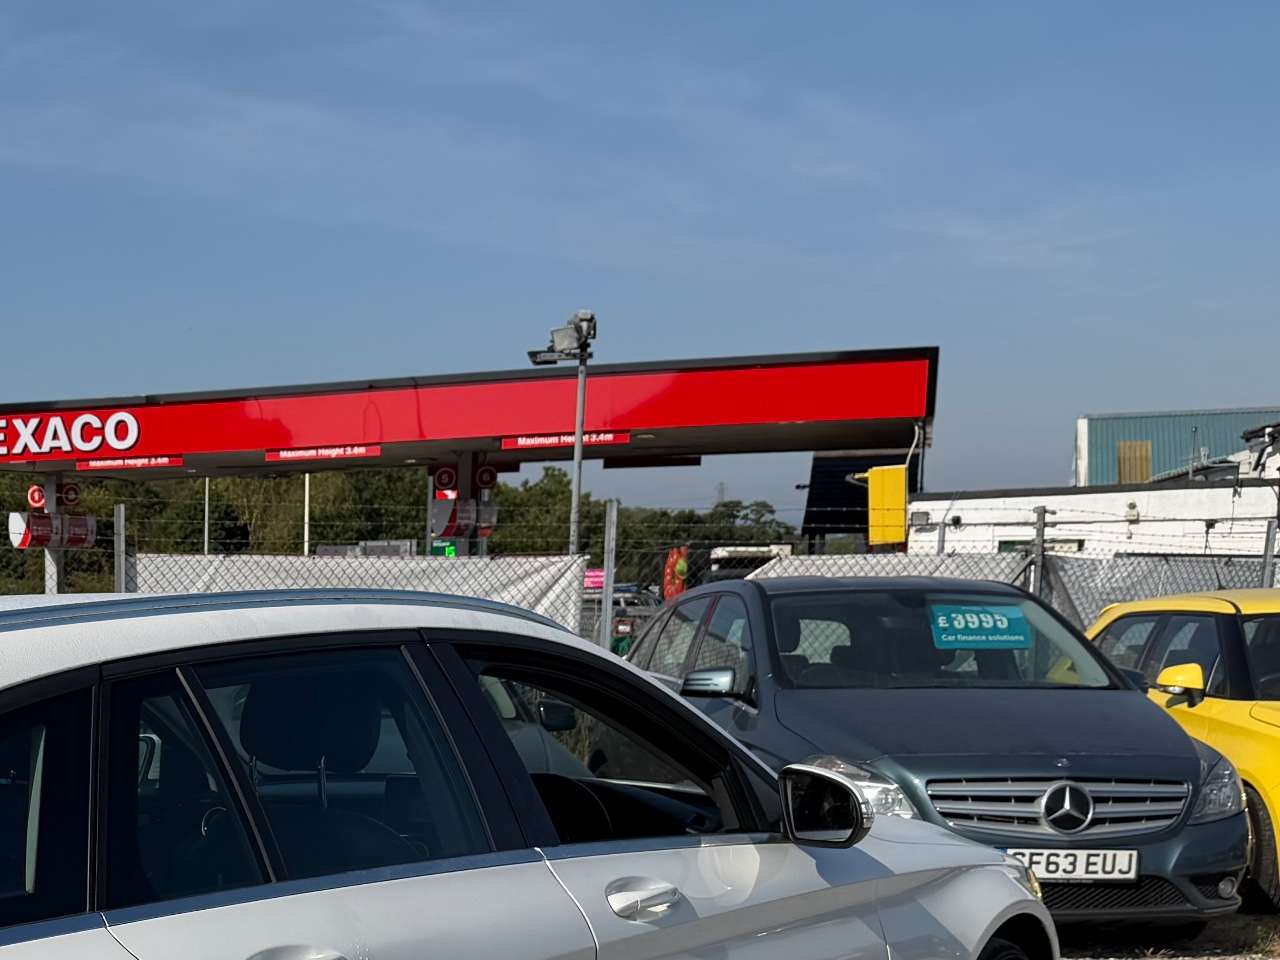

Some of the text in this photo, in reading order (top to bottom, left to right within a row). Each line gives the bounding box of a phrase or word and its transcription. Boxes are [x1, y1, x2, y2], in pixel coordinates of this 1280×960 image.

[517, 436, 559, 445] Maximum
[279, 449, 317, 458] Maximum
[318, 447, 345, 458] Height
[88, 459, 124, 467] Maximum
[125, 458, 149, 467] Height
[957, 633, 986, 641] finance
[1084, 852, 1134, 875] EUJ
